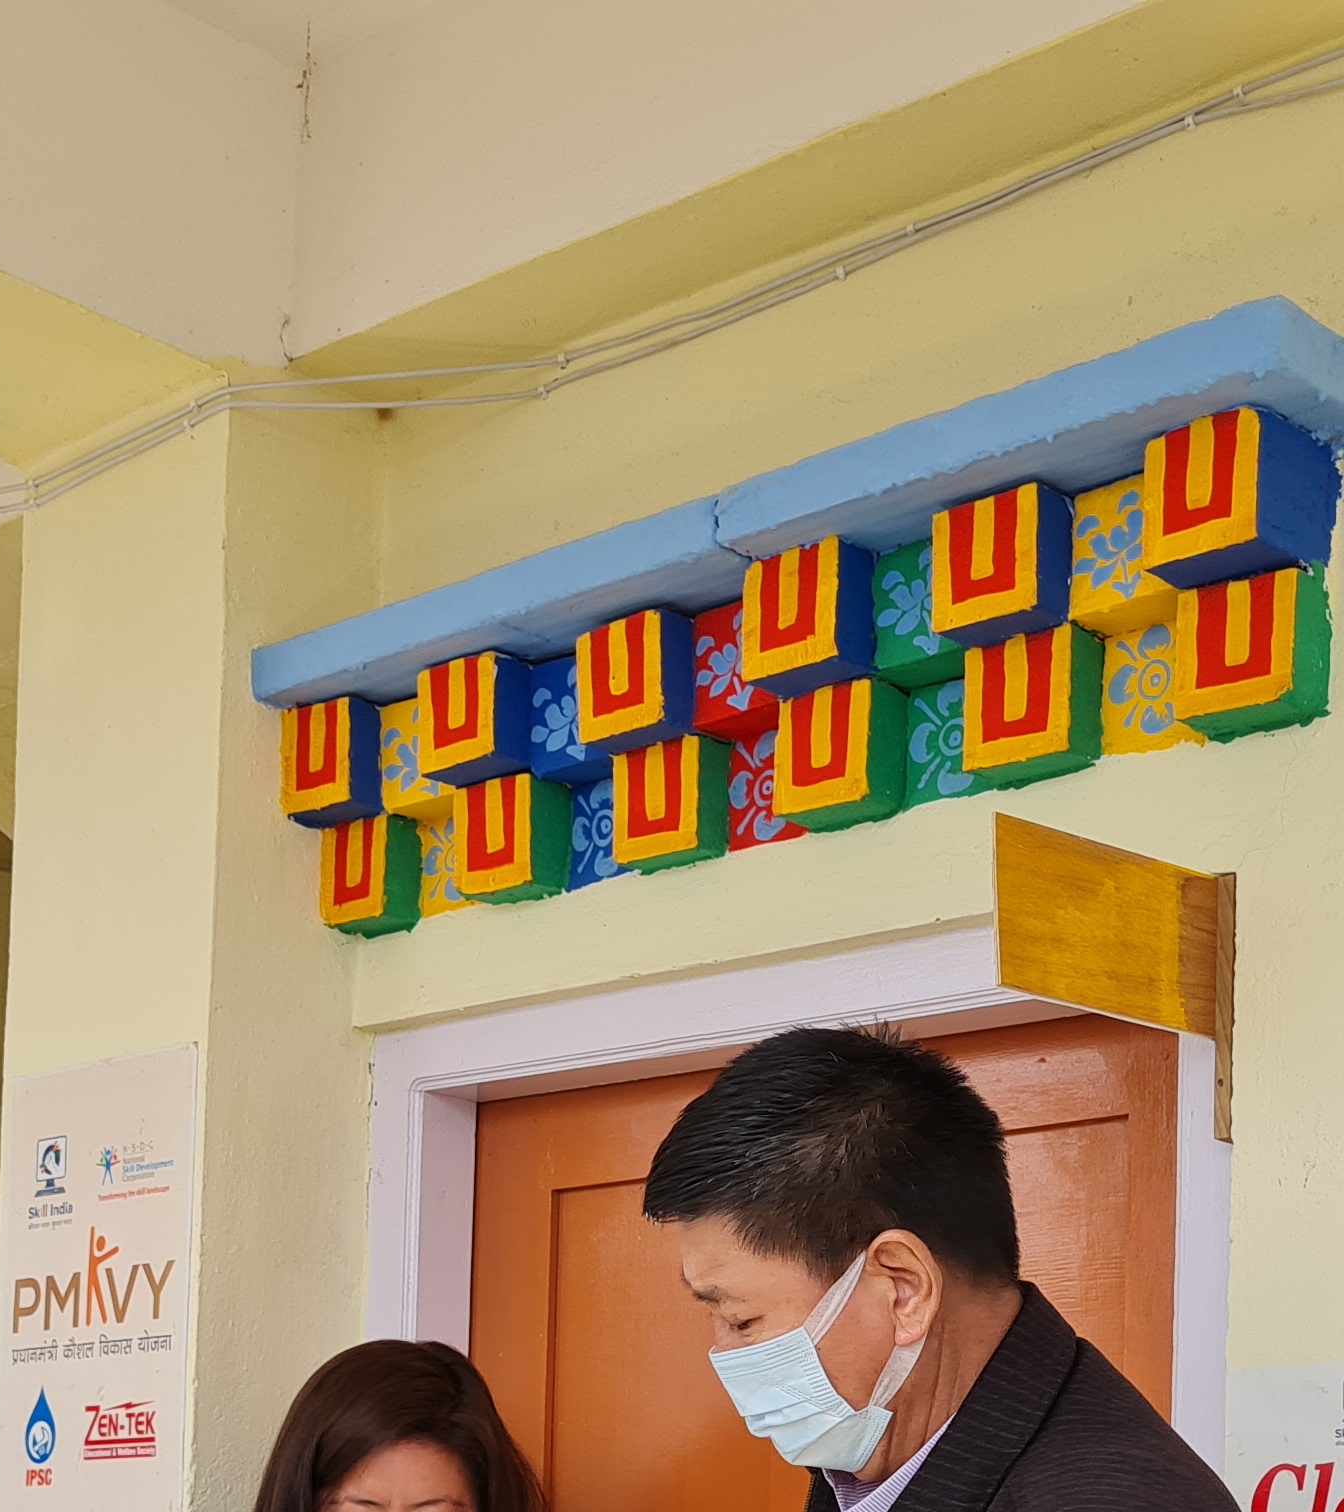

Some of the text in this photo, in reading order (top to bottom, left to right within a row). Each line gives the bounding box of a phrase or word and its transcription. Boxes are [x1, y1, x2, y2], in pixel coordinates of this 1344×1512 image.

[28, 1202, 73, 1219] Skill India
[12, 1226, 176, 1334] PMKVY
[12, 1329, 173, 1365] प्रधानमंत्री कौशल विकास योजना
[84, 1405, 156, 1446] ZEN-TEK
[25, 1468, 53, 1487] IPSC
